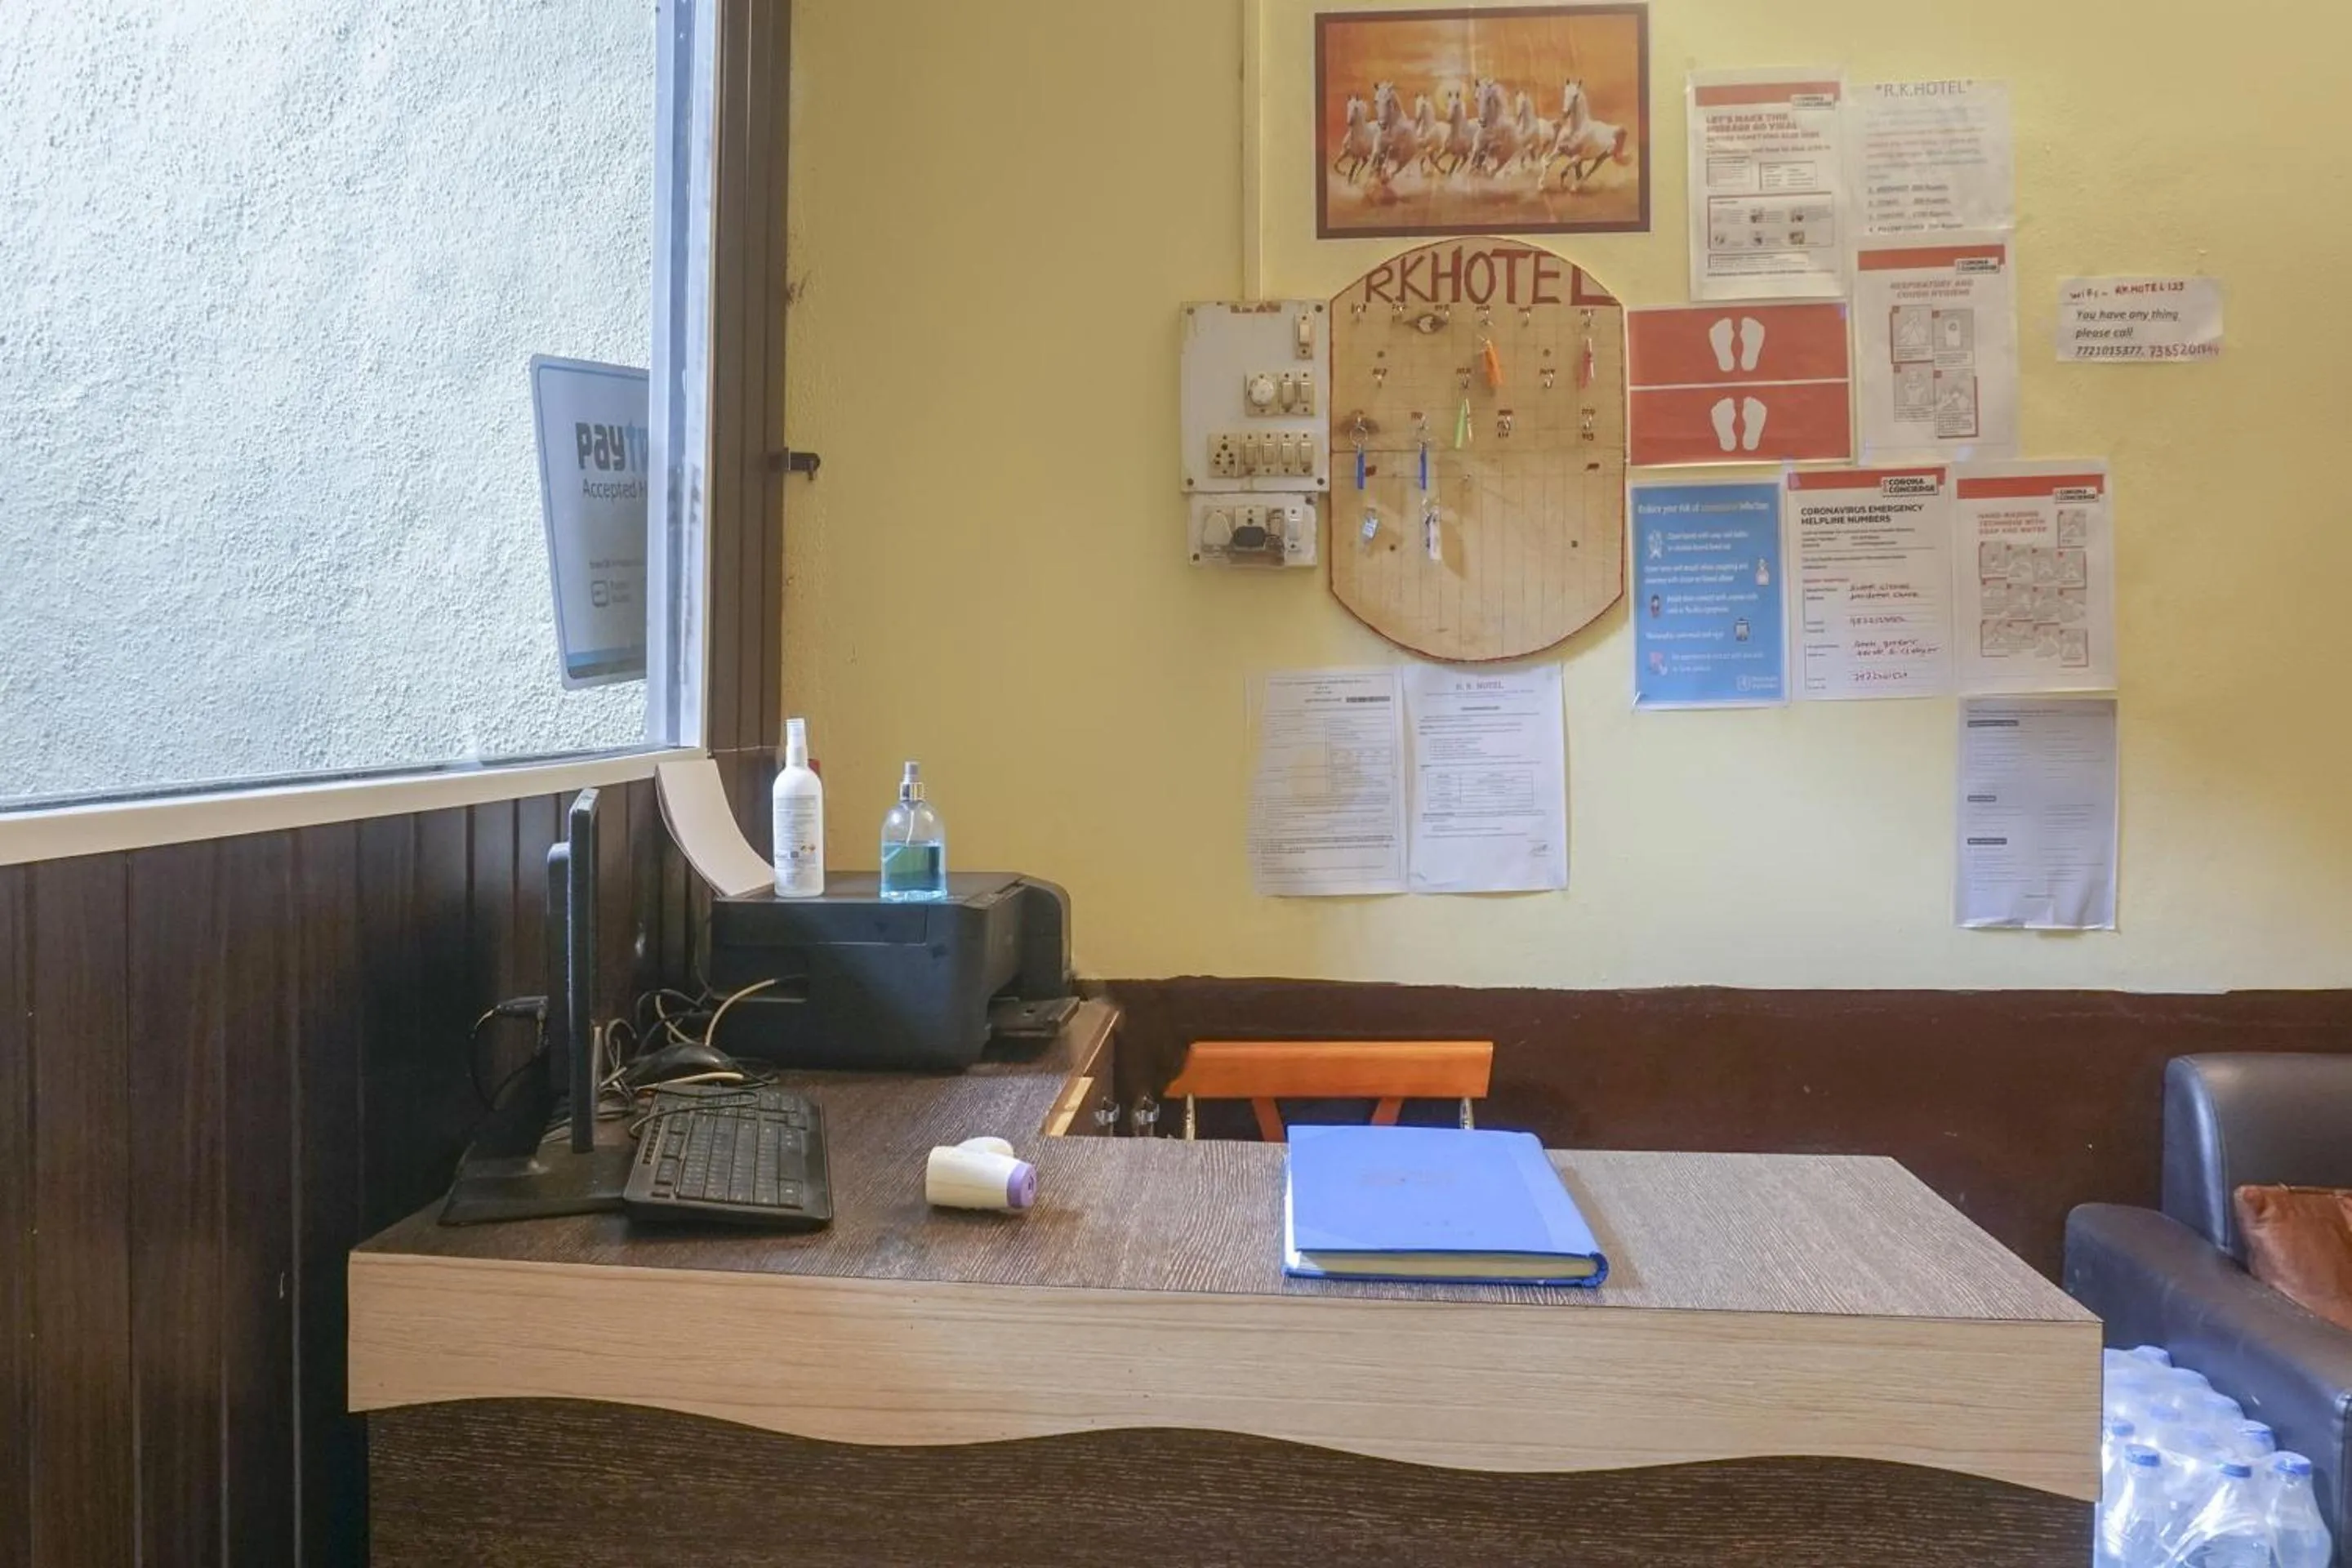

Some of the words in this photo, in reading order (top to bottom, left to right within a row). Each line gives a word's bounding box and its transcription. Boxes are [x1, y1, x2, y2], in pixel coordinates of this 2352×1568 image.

[2075, 327, 2111, 340] please
[2113, 327, 2134, 337] call
[583, 478, 637, 503] Accepted
[1800, 506, 1866, 516] CORONAVIRUS
[1868, 504, 1924, 514] EMERGENCY
[1800, 515, 1845, 525] HELPLINE
[1847, 514, 1892, 523] NUMBERS
